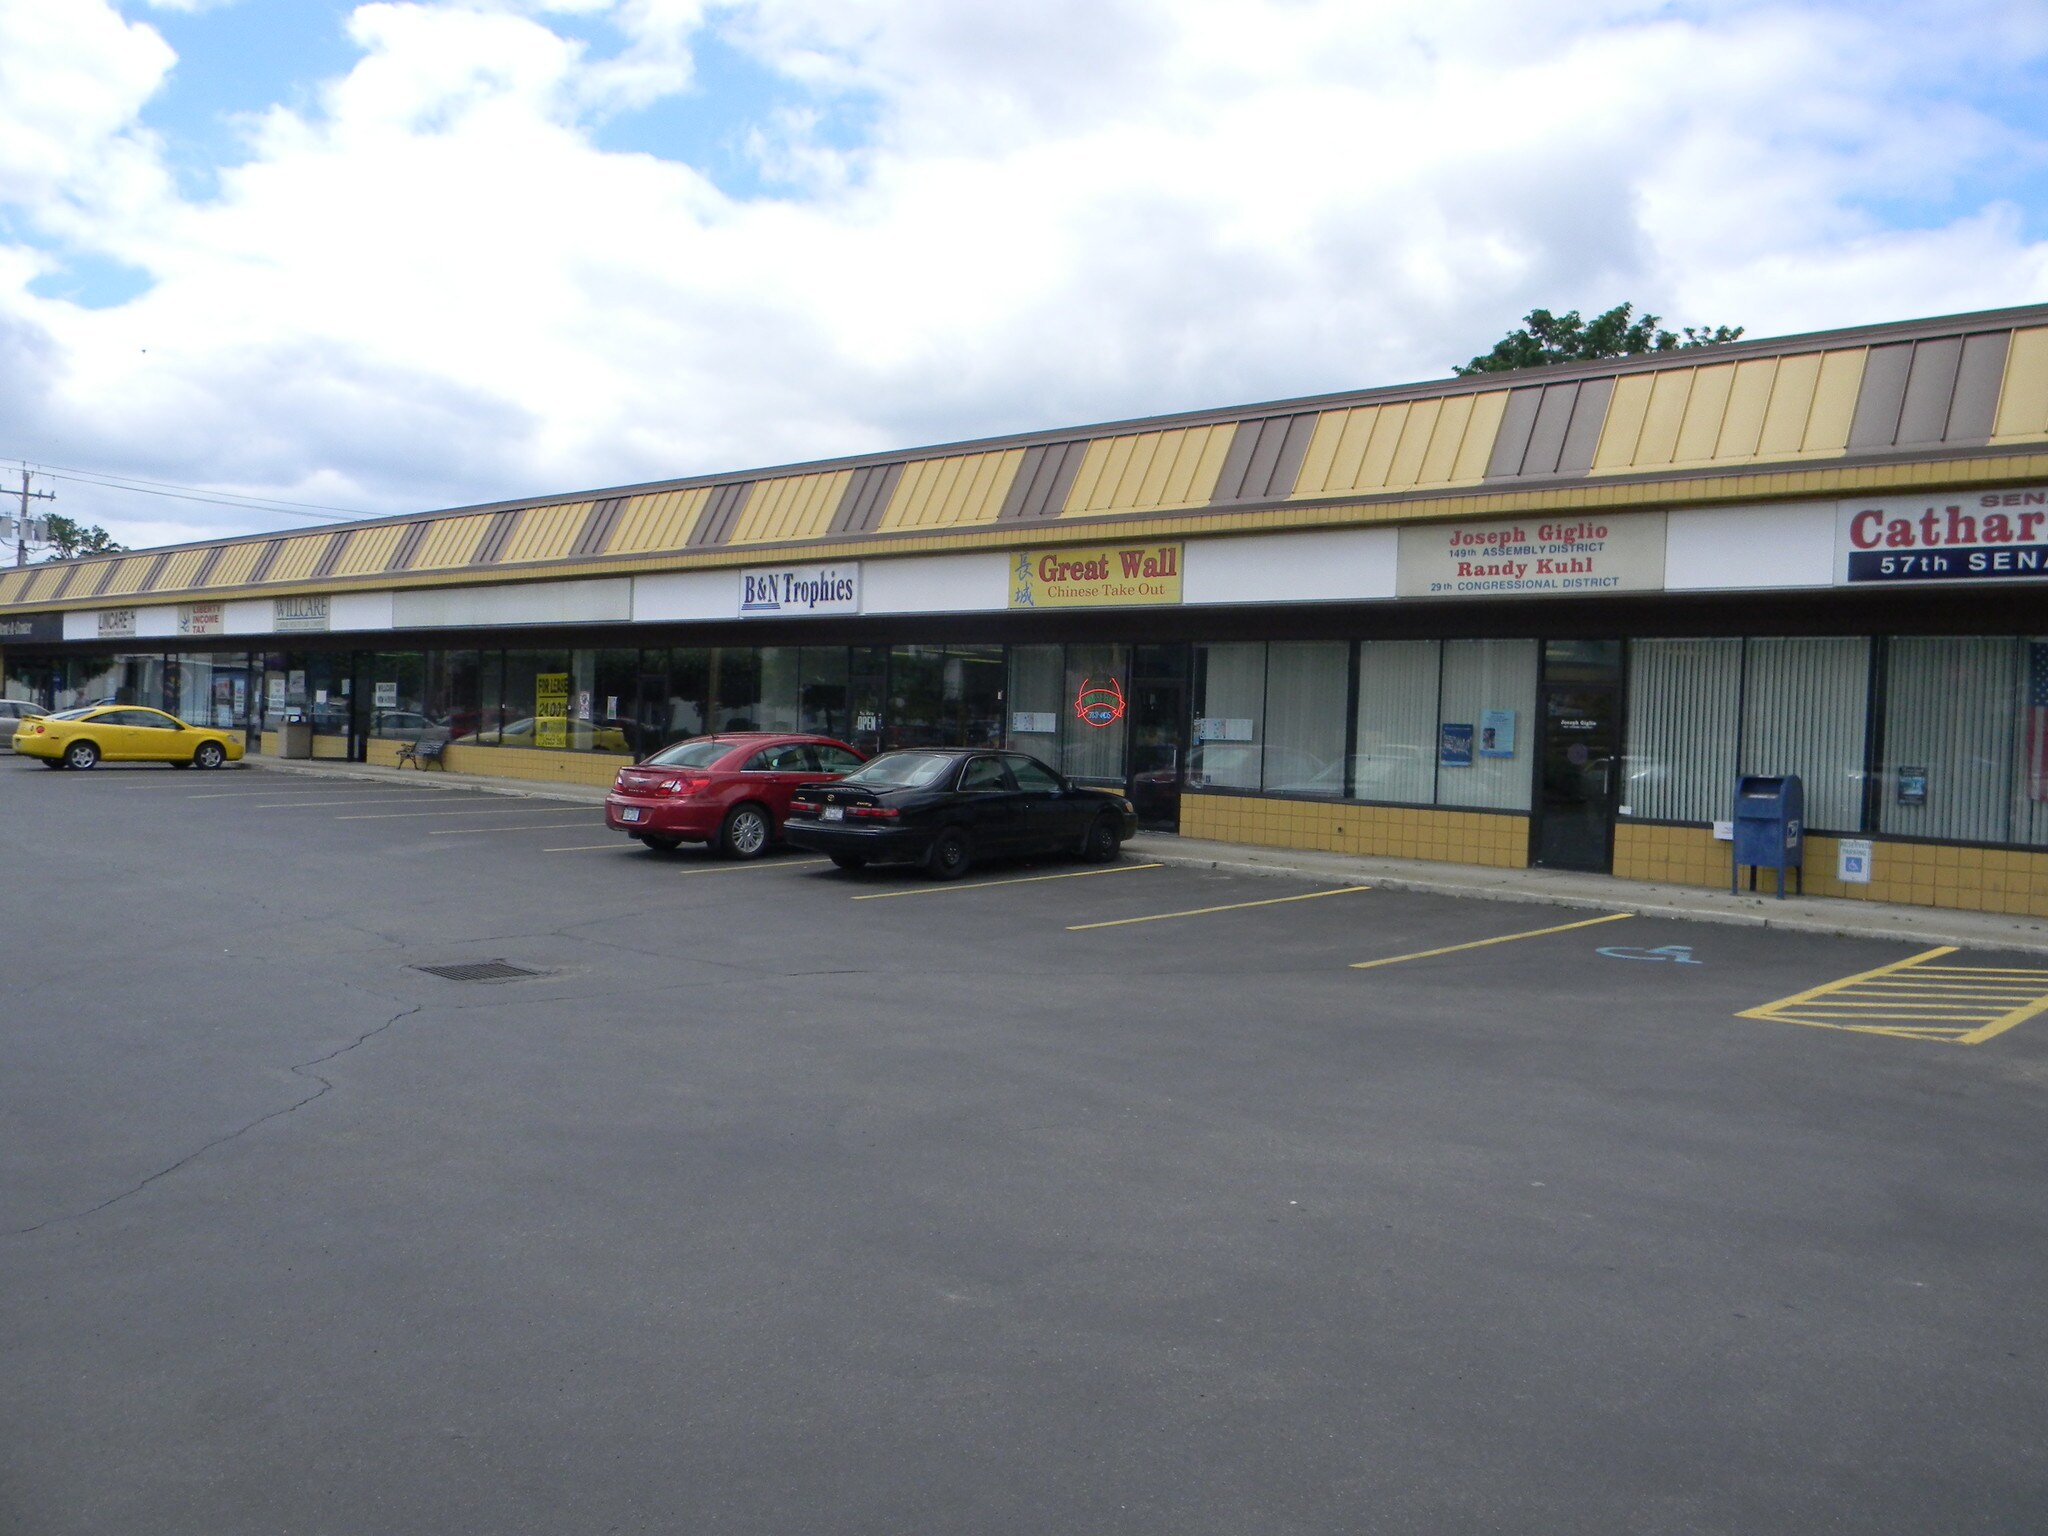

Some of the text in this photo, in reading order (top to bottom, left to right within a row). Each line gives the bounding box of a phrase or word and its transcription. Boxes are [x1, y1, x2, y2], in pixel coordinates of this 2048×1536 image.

[1980, 492, 2048, 507] SEN
[1450, 522, 1608, 548] Joseph Giglio
[1850, 505, 2048, 549] Cathar
[1450, 542, 1604, 558] 149th ASSEMBLY DISTRICT
[1038, 548, 1177, 582] Great Wall
[1457, 557, 1593, 579] Randy Kuhl
[1880, 551, 2048, 574] 57th SEN
[744, 570, 853, 608] B&N Trophies
[1047, 582, 1165, 598] Chinese Take Out
[1457, 579, 1558, 591] CONGRESSIONAL
[1562, 577, 1620, 588] DISTRICT
[192, 604, 220, 614] LIBERTY
[275, 598, 327, 617] WILLCARE
[192, 614, 219, 624] INCOME
[192, 625, 206, 634] TAX
[538, 677, 568, 694] FOR LEASE
[857, 715, 876, 730] OPEN
